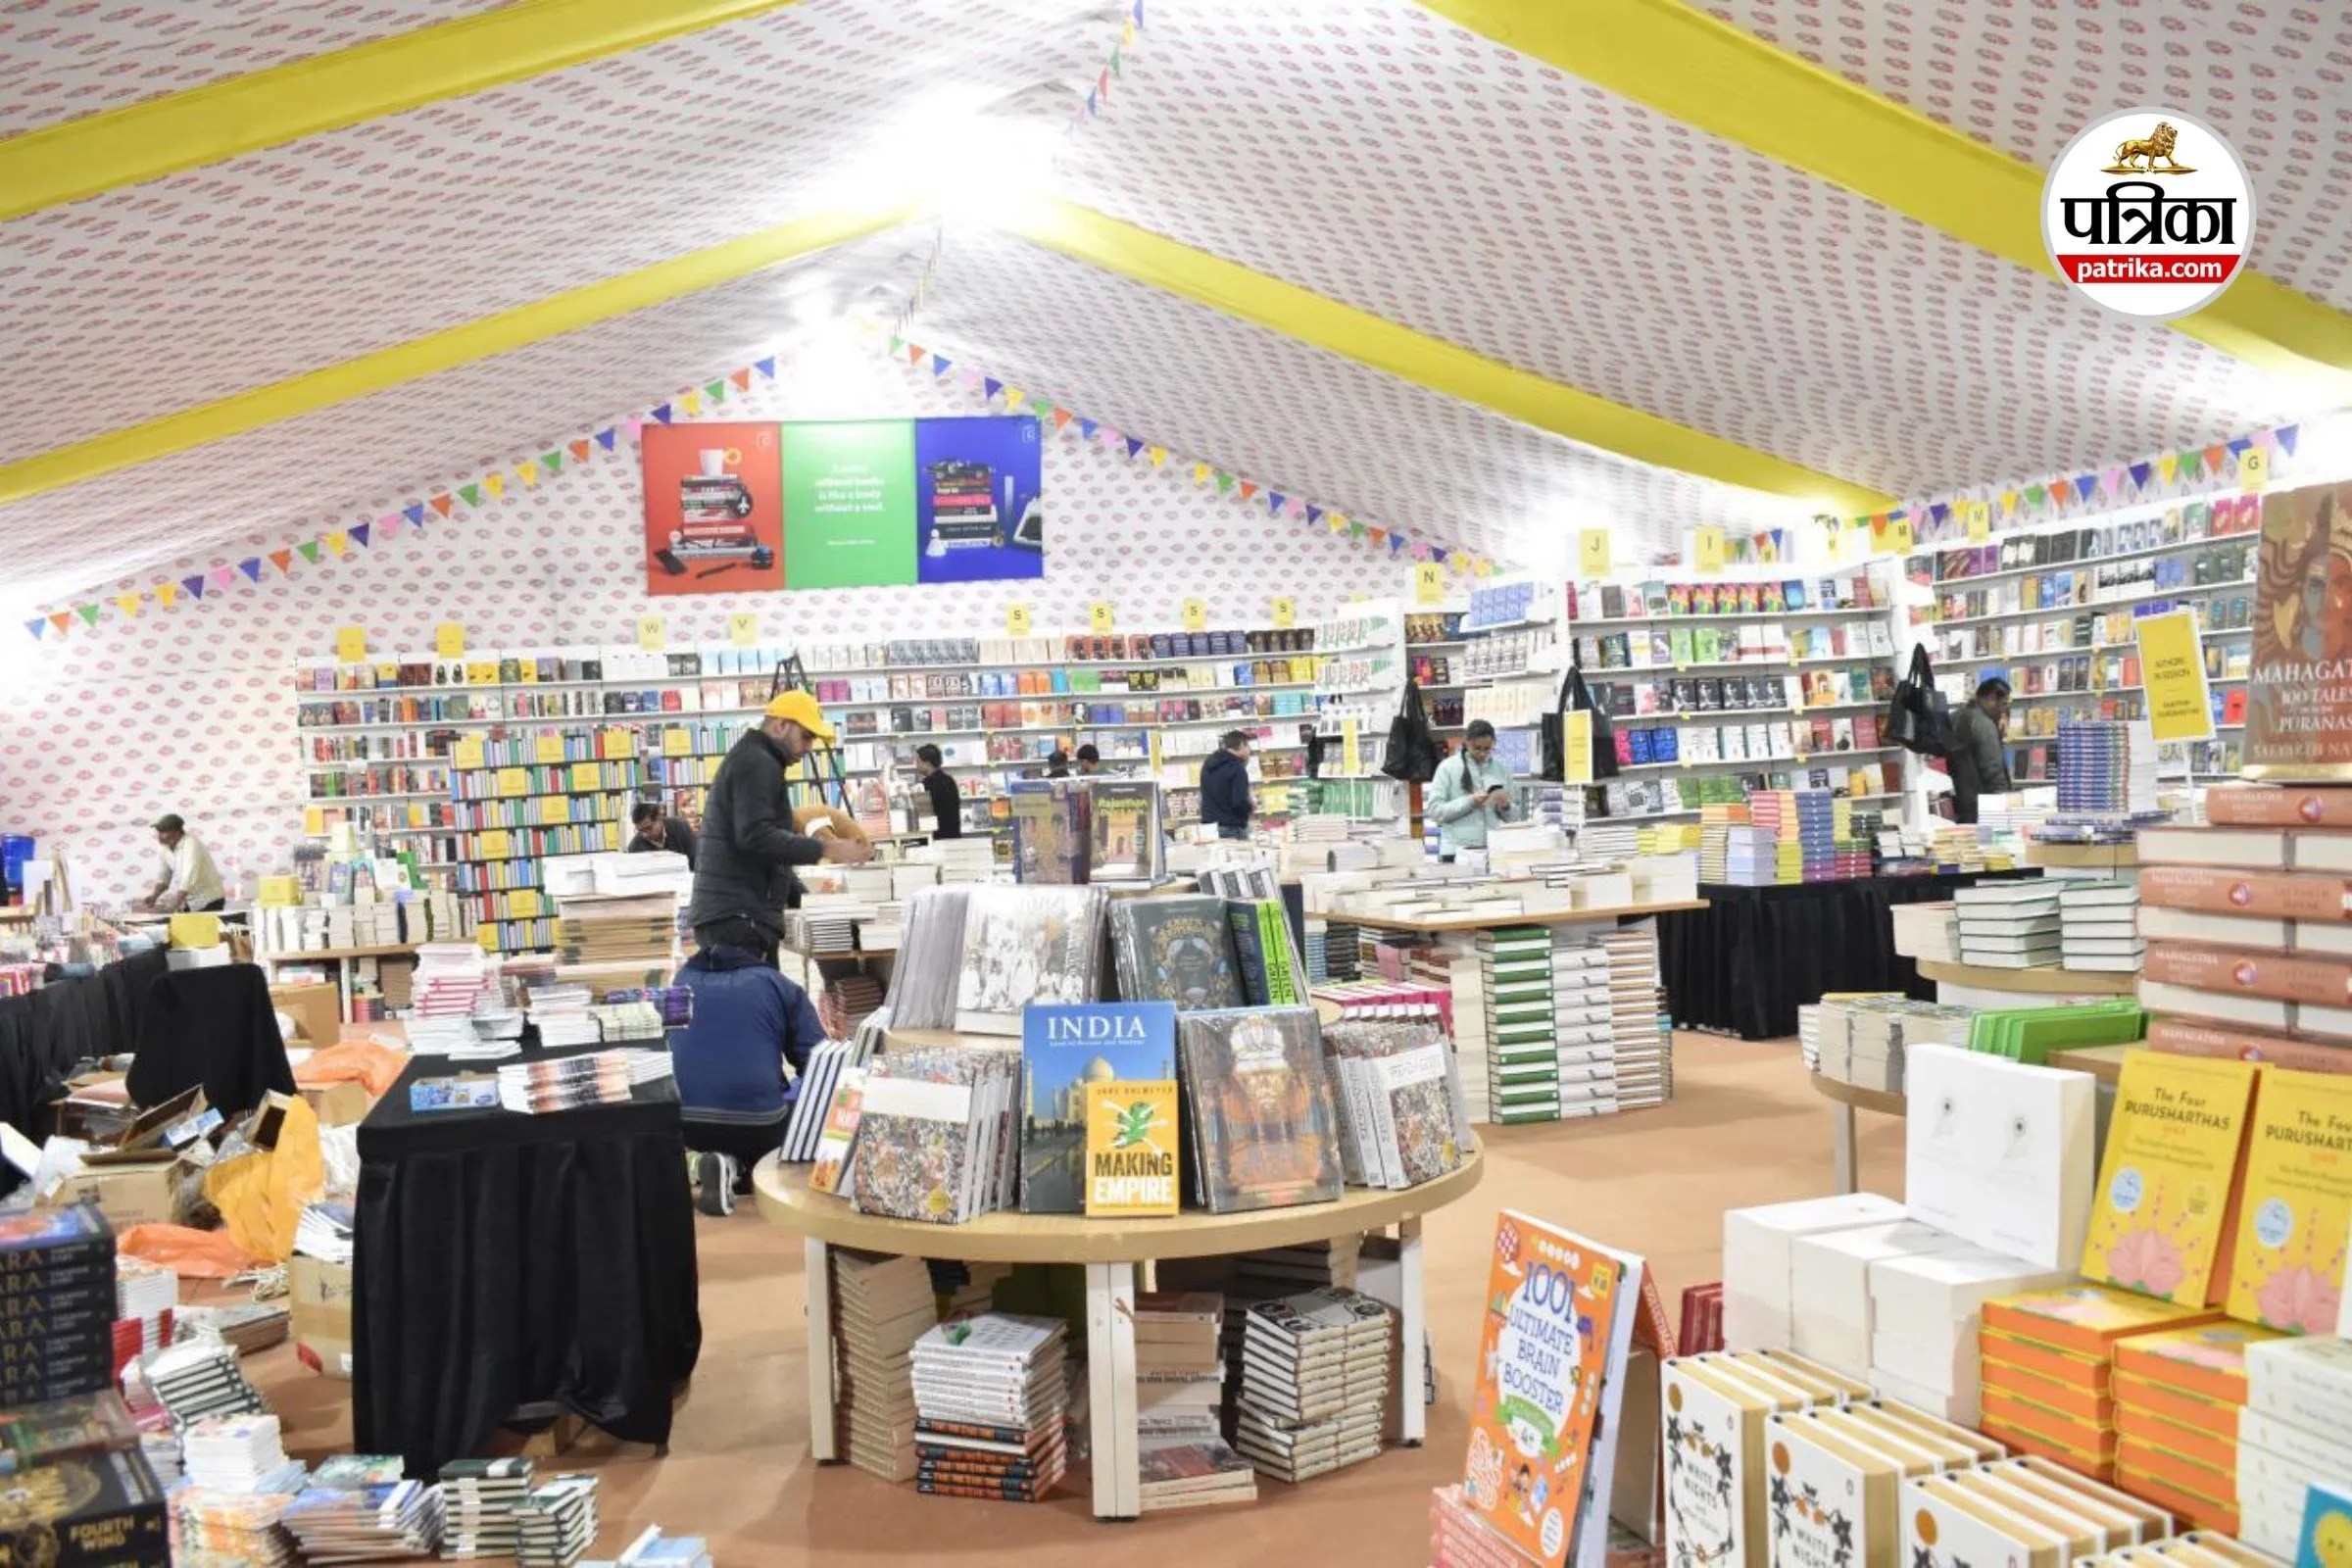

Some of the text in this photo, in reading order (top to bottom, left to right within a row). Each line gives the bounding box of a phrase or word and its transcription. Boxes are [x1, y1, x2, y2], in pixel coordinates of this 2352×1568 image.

[2248, 455, 2259, 470] G
[1590, 536, 1600, 553] J
[1423, 570, 1435, 584] N
[1013, 610, 1022, 620] S
[1097, 607, 1105, 618] S
[1190, 605, 1199, 615] S
[1280, 603, 1288, 613] S
[646, 623, 659, 634] W
[737, 618, 747, 629] V
[1047, 1015, 1147, 1040] INDIA
[2155, 1087, 2206, 1106] The Four
[2124, 1101, 2230, 1131] PURUSHARTHAS
[2298, 1109, 2322, 1128] The
[1095, 1152, 1174, 1177] MAKING
[1094, 1176, 1174, 1204] EMPIRE
[1522, 1260, 1576, 1323] 1001
[1509, 1302, 1574, 1356] ULTIMATE
[1518, 1338, 1561, 1378] BRAIN
[1503, 1361, 1565, 1415] BOOSTER
[70, 1514, 135, 1543] FOURTH
